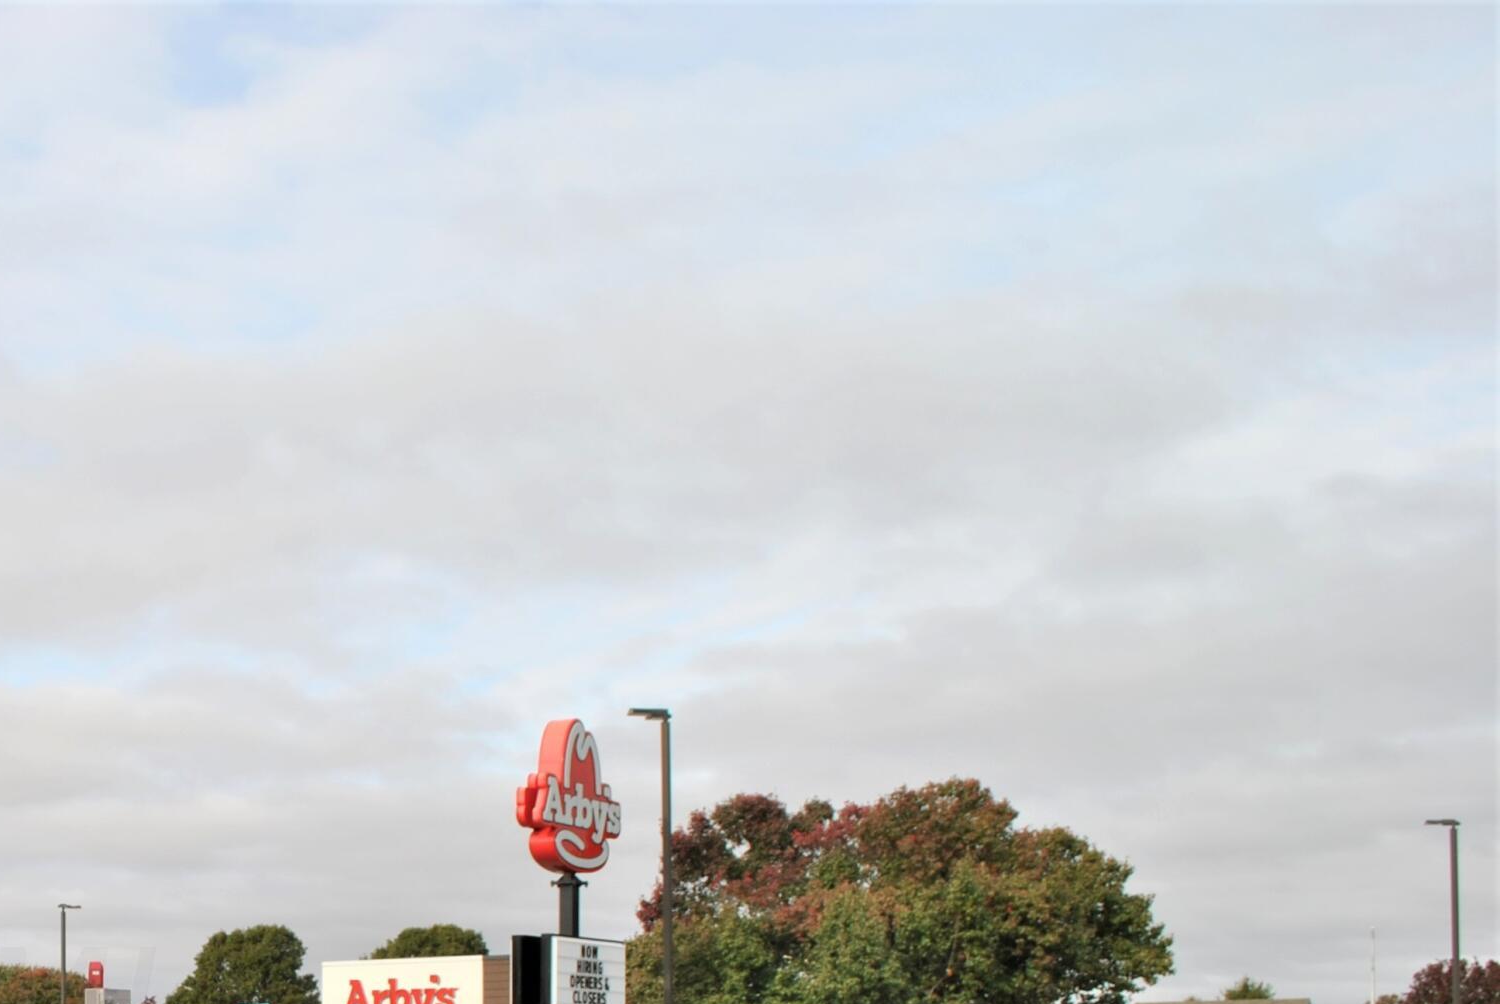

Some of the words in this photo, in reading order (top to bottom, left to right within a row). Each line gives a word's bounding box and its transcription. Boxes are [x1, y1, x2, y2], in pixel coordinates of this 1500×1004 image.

[543, 775, 620, 844] Arby's
[581, 945, 598, 958] NOW
[577, 960, 602, 975] HIRING
[570, 975, 602, 990] OPENERS
